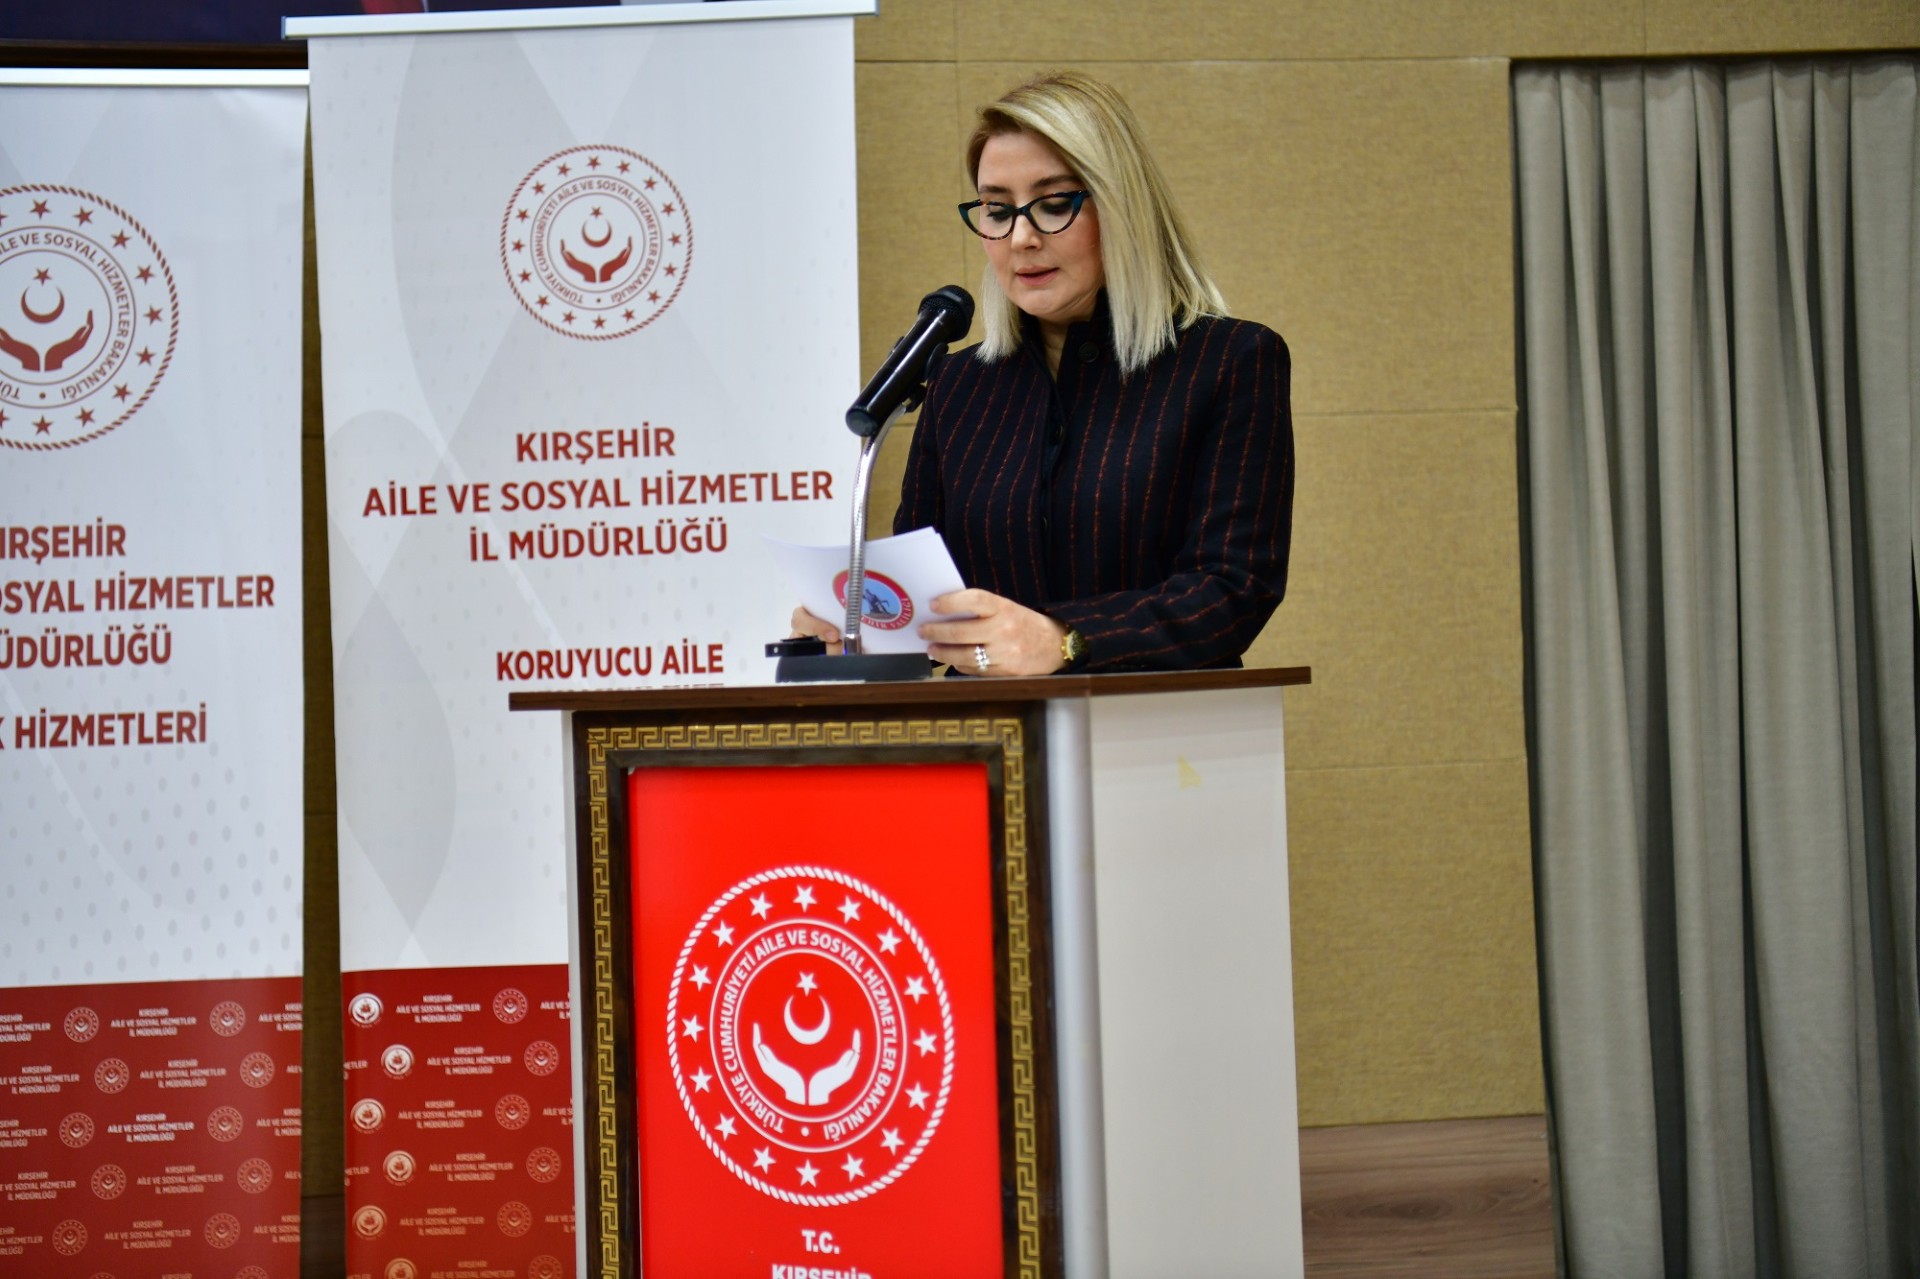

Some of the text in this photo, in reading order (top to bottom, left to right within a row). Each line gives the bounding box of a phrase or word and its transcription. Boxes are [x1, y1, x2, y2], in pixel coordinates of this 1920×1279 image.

[558, 184, 579, 202] AİLE
[580, 180, 594, 191] VE
[596, 180, 632, 200] SOSYAL
[20, 233, 40, 246] VE
[43, 233, 98, 263] SOSYAL
[634, 197, 659, 257] HİZMETLER
[97, 258, 130, 338] HİZMETLER
[546, 272, 582, 304] TÜRKİYE
[610, 258, 656, 303] BAKANLIĞI
[61, 340, 126, 400] BAKANLIĞI
[516, 422, 676, 464] KIRŞEHİR
[362, 470, 834, 517] AİLE VE SOSYAL HİZMETLER
[470, 517, 728, 562] İL MÜDÜRLÜĞÜ
[0, 571, 274, 614] SYAL HİZMETLER
[496, 638, 724, 681] KORUYUCU AİLE
[15, 702, 206, 749] HİZMETLERİ
[720, 930, 898, 1142] TÜRKİYE CUMHURİYETİ AİLE VE SOSYAL HİZMETLER BAKANLIĞI
[802, 1229, 840, 1254] T.C.
